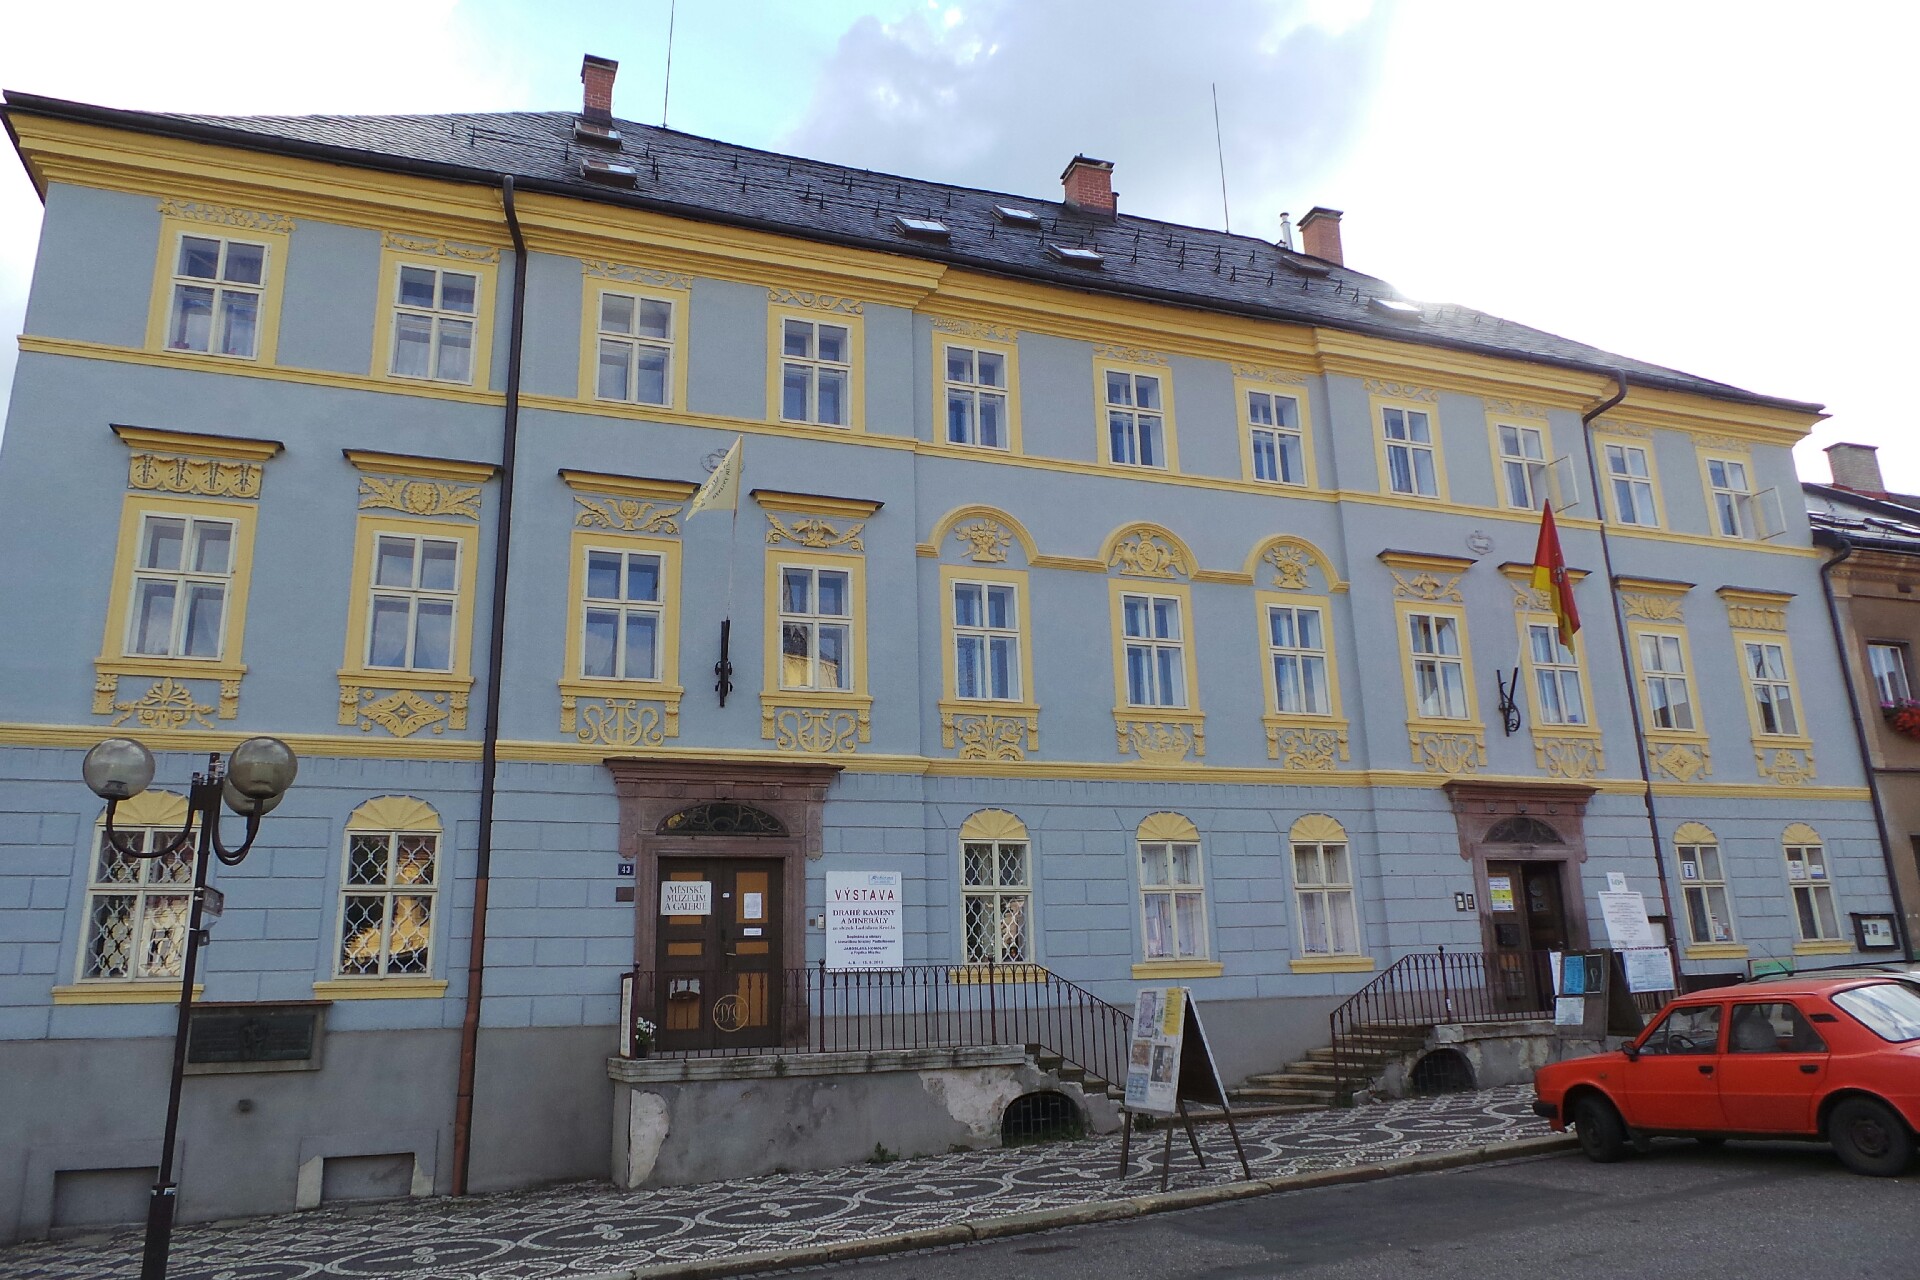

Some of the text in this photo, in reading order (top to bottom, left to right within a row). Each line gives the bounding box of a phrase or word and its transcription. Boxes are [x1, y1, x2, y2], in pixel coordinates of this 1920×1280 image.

[669, 884, 703, 894] MĚSTSKÉ
[835, 887, 894, 900] VÝSTAVA
[667, 894, 706, 902] MUZEUM
[664, 902, 706, 911] A GALERIE
